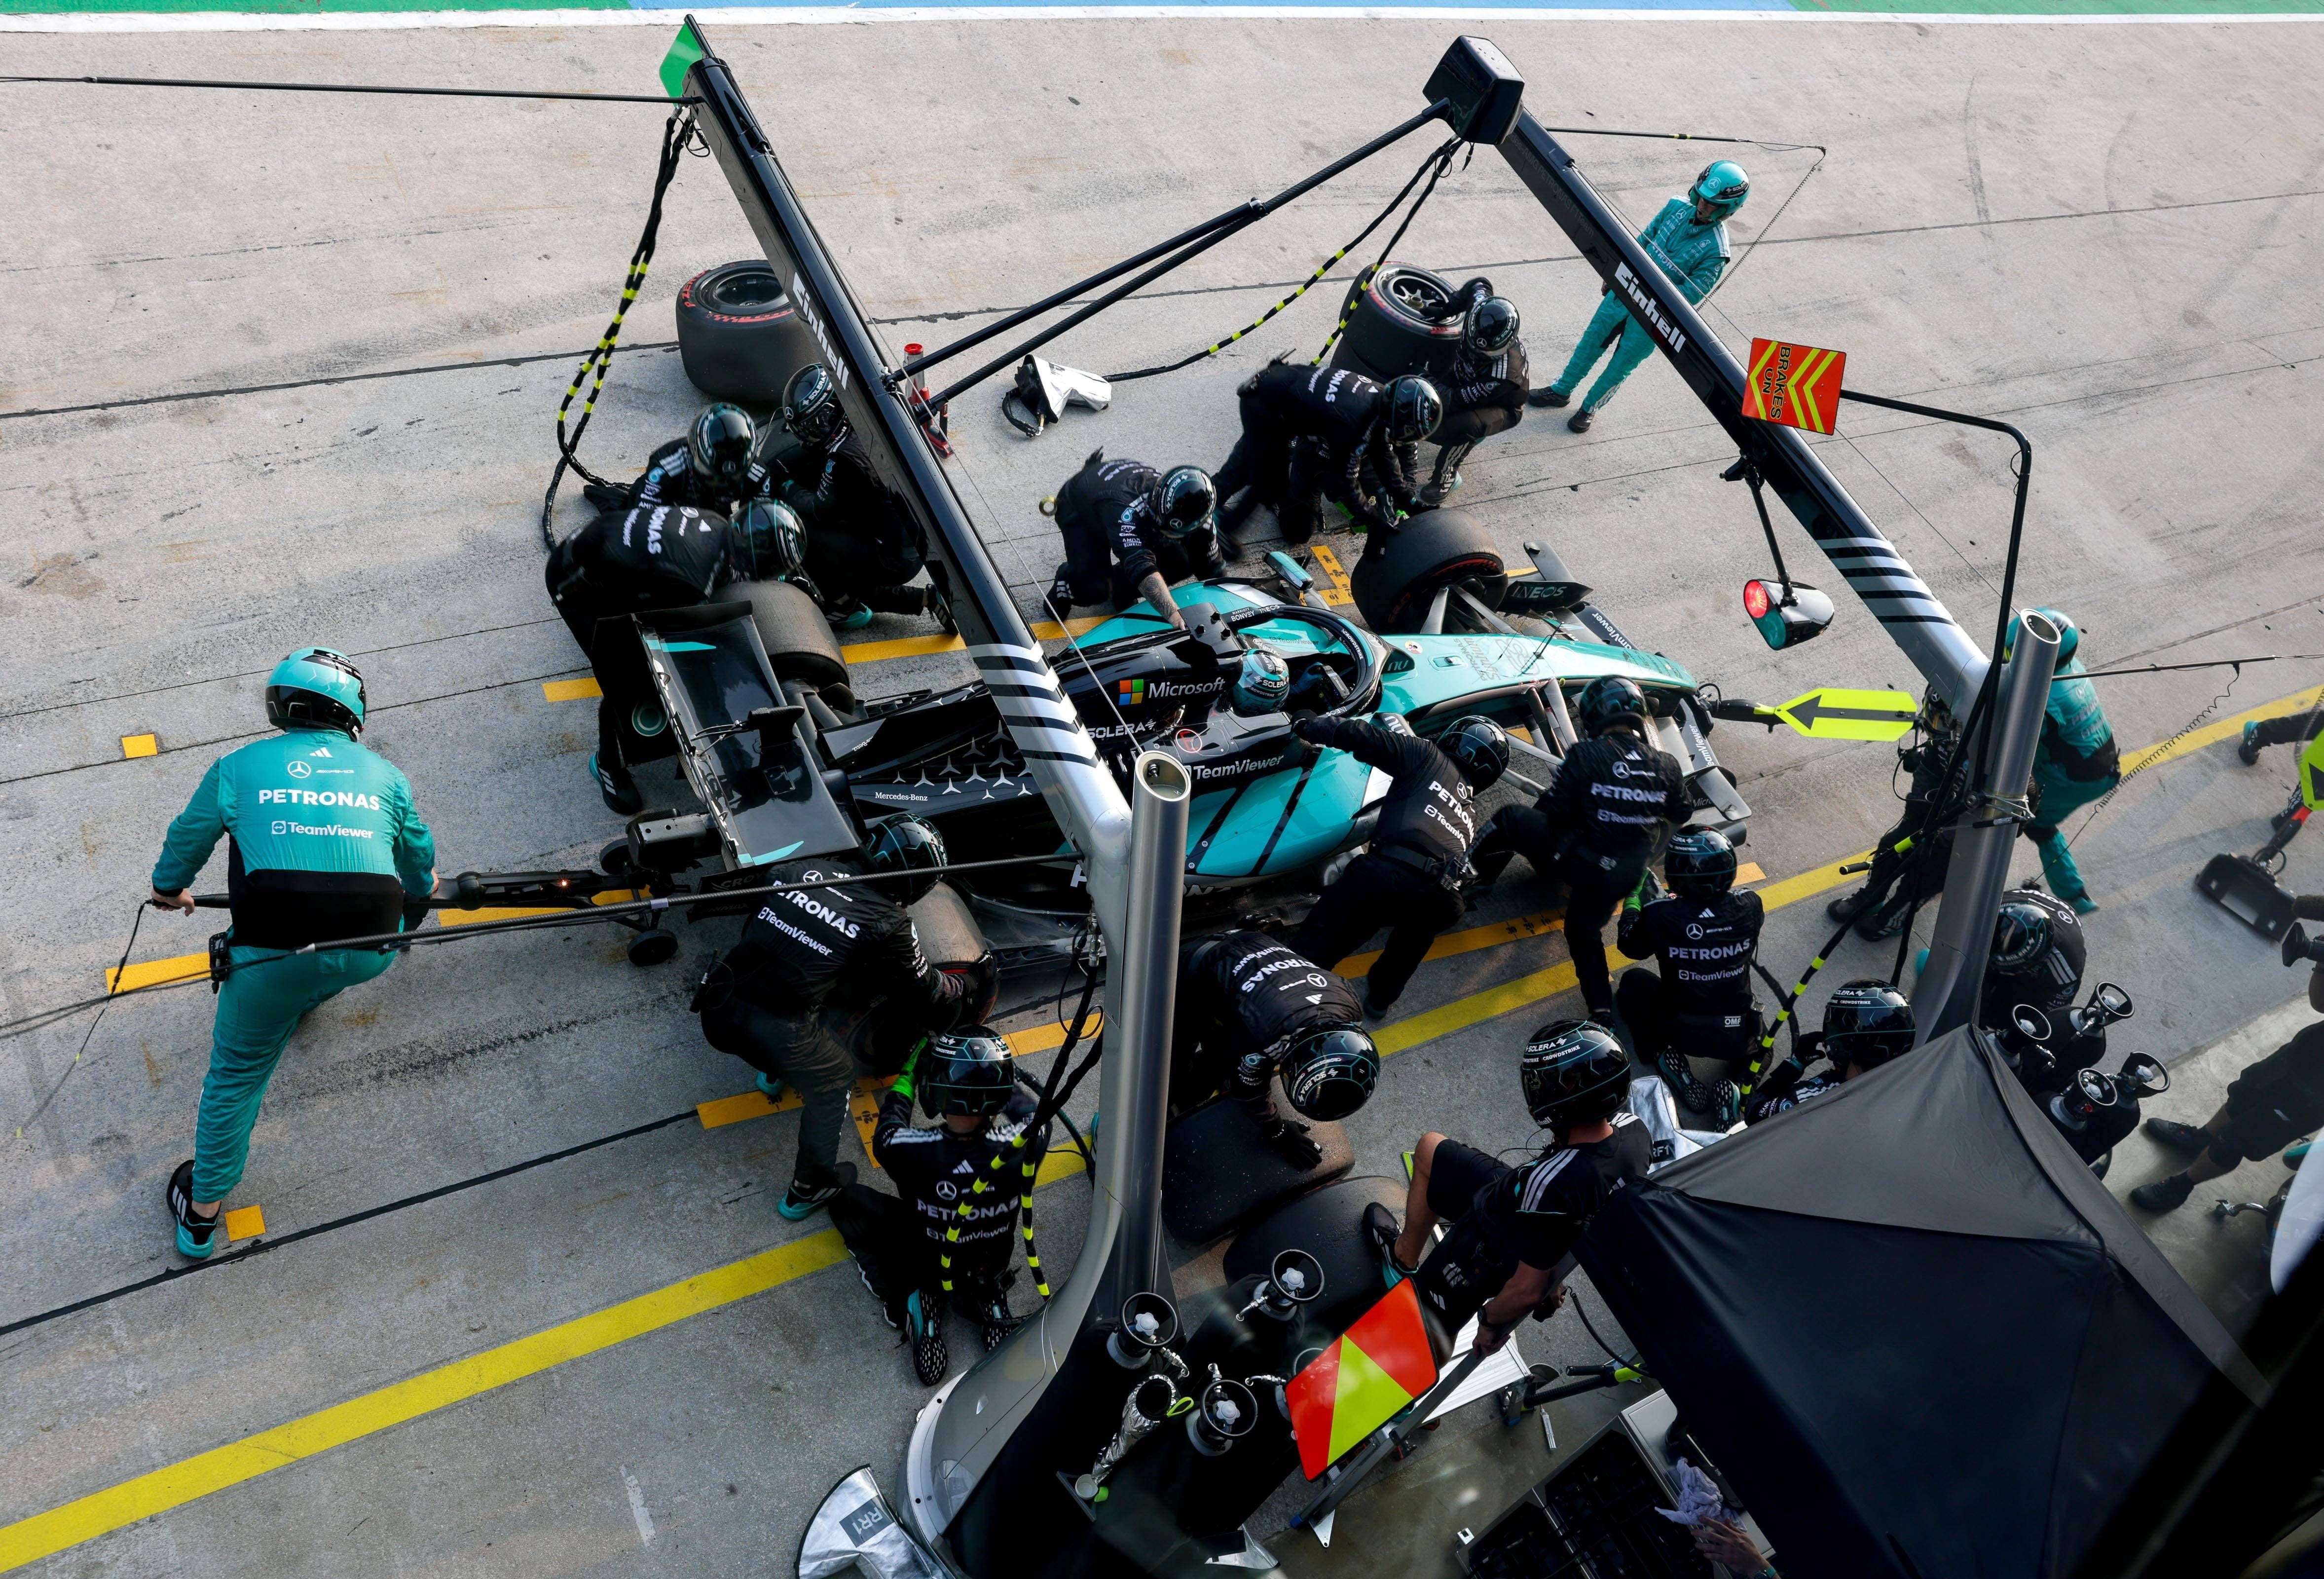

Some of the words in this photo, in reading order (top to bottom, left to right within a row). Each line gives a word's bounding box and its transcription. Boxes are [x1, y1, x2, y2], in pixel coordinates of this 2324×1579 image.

[1615, 262, 1686, 353] Einhell
[792, 271, 849, 391] Einhell
[809, 376, 826, 401] SOLERA
[1762, 367, 1774, 394] ON
[1770, 345, 1791, 419] BRAKES
[1471, 386, 1480, 398] IWC
[1167, 478, 1181, 502] SOLERA
[1512, 585, 1567, 599] INEOS
[1231, 610, 1254, 622] BONVOY
[1259, 604, 1280, 614] INEOS
[1343, 631, 1364, 660] CROWDSTRIKE
[1148, 677, 1226, 699] Microsoft
[1248, 686, 1275, 697] CROWDSTRIKE
[1262, 679, 1287, 688] SOLERA
[1326, 706, 1348, 716] INEOS
[1088, 722, 1146, 739] SOLERA
[1689, 724, 1716, 767] eamViewer
[1193, 755, 1285, 780] TeamViewer
[258, 789, 379, 811] PETRONAS
[875, 791, 928, 801] Mercedes-Benz
[287, 822, 374, 839] TeamViewer
[765, 911, 833, 956] TeamViewer
[1668, 938, 1750, 960] PETRONAS
[1690, 964, 1745, 981] TeamViewer
[1528, 1042, 1556, 1053] SOLERA
[1543, 1045, 1581, 1061] CROWDSTRIKE
[1299, 1071, 1328, 1095] SOLERA
[852, 1506, 883, 1535] RR1
